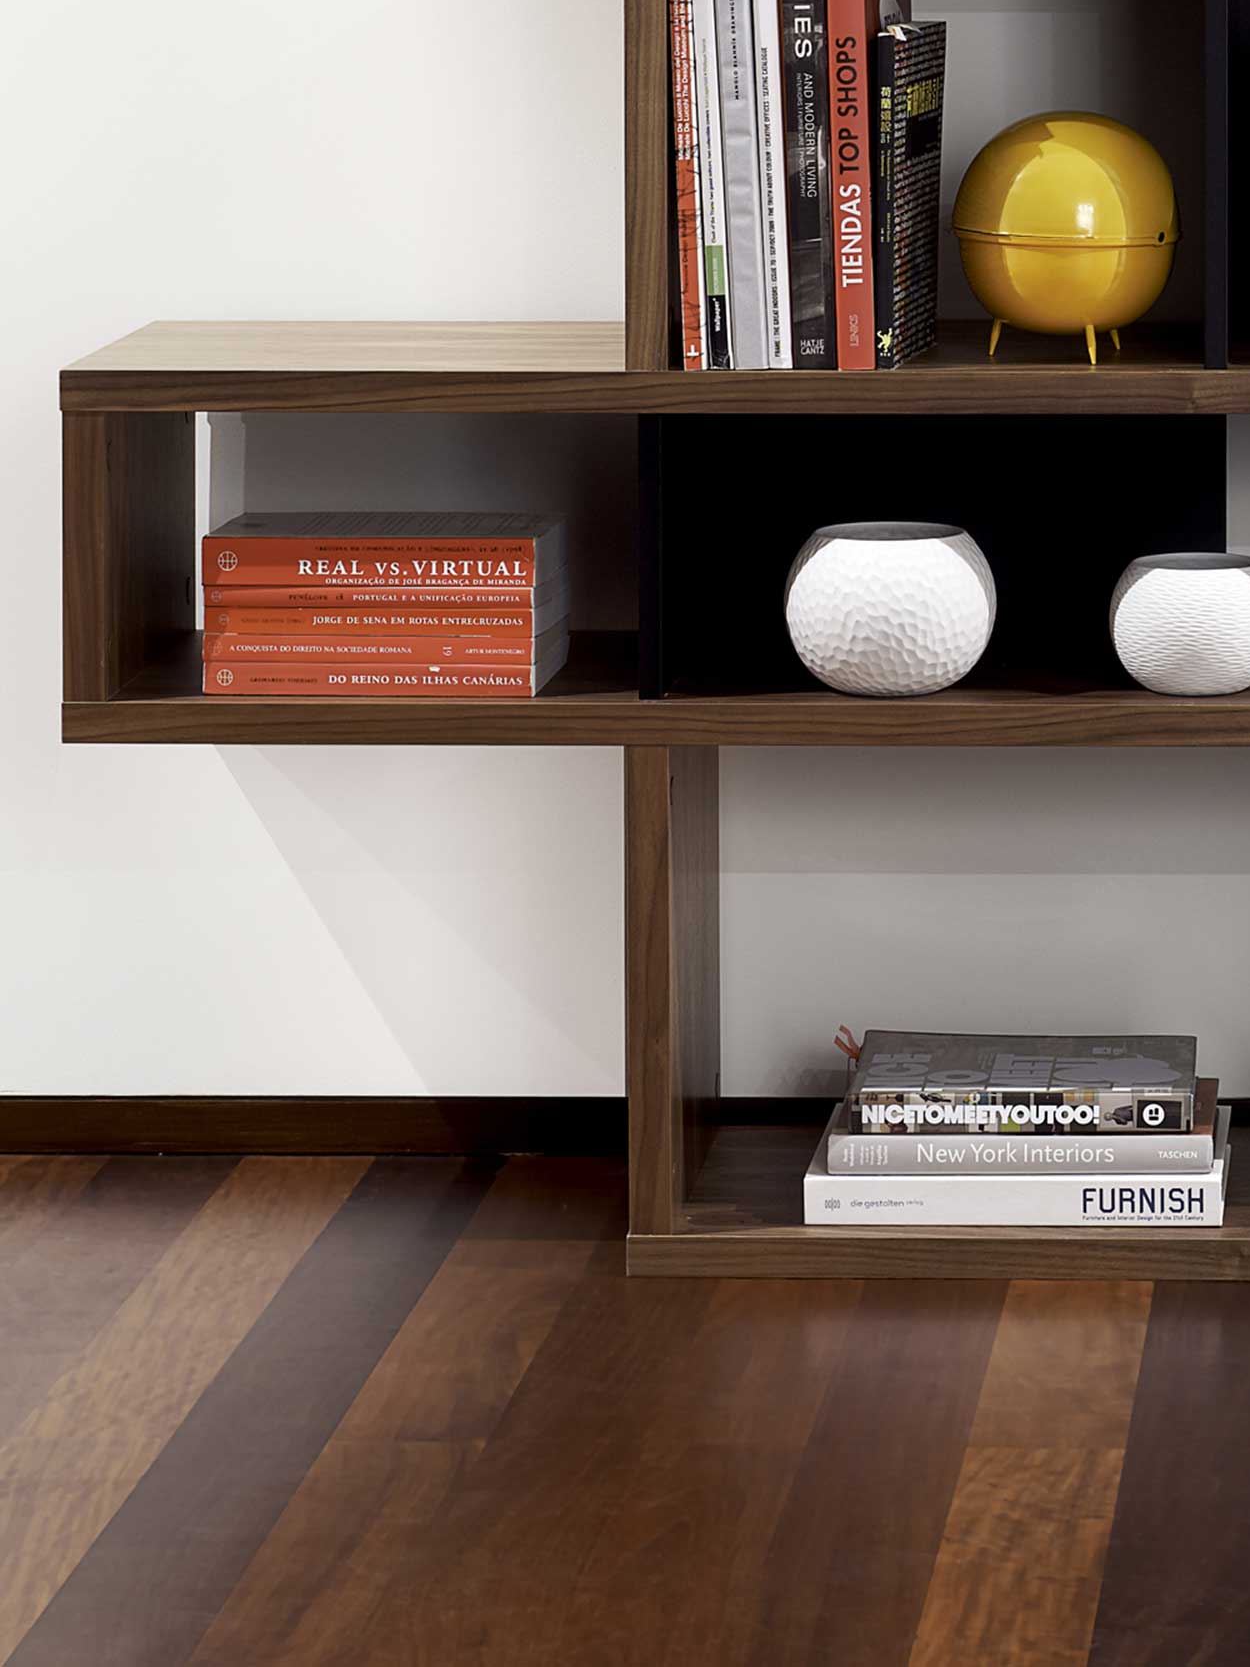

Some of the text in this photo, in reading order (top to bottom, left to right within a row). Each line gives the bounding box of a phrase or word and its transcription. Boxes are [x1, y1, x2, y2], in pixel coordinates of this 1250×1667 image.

[803, 72, 817, 198] AND MODERN LIVING
[835, 36, 863, 288] TIENDAS TOP SHOPS
[800, 339, 825, 347] HATJE
[800, 346, 825, 355] CANTZ
[298, 559, 364, 576] REAL
[412, 559, 527, 576] VIRTUAL
[325, 577, 385, 586] ORGANIZAÇÃO
[425, 578, 469, 587] BRAGANÇA
[352, 594, 398, 602] PORTUGAL
[419, 594, 473, 604] UNIFICAÇÃO
[312, 616, 343, 625] JORGE
[346, 616, 360, 625] DE
[363, 616, 388, 625] SENA
[390, 617, 405, 625] EM
[409, 617, 439, 625] ROTAS
[442, 617, 524, 626] ENTRECRUZADAS
[236, 645, 278, 653] CONQUISTA
[293, 645, 322, 653] DIREITO
[336, 646, 377, 654] SOCIEDADE
[379, 646, 412, 654] ROMANA
[328, 674, 347, 685] DO
[351, 675, 390, 685] REINO
[394, 675, 418, 685] DAS
[422, 676, 458, 685] ILHAS
[462, 673, 523, 686] CANÁRIAS
[861, 1103, 1100, 1125] NICETOMEETYOUTOO!
[917, 1141, 1115, 1164] New York Interiors
[1158, 1150, 1198, 1159] TASCHEN
[850, 1199, 863, 1208] die
[863, 1199, 905, 1210] gestalten
[1082, 1187, 1204, 1214] FURNISH
